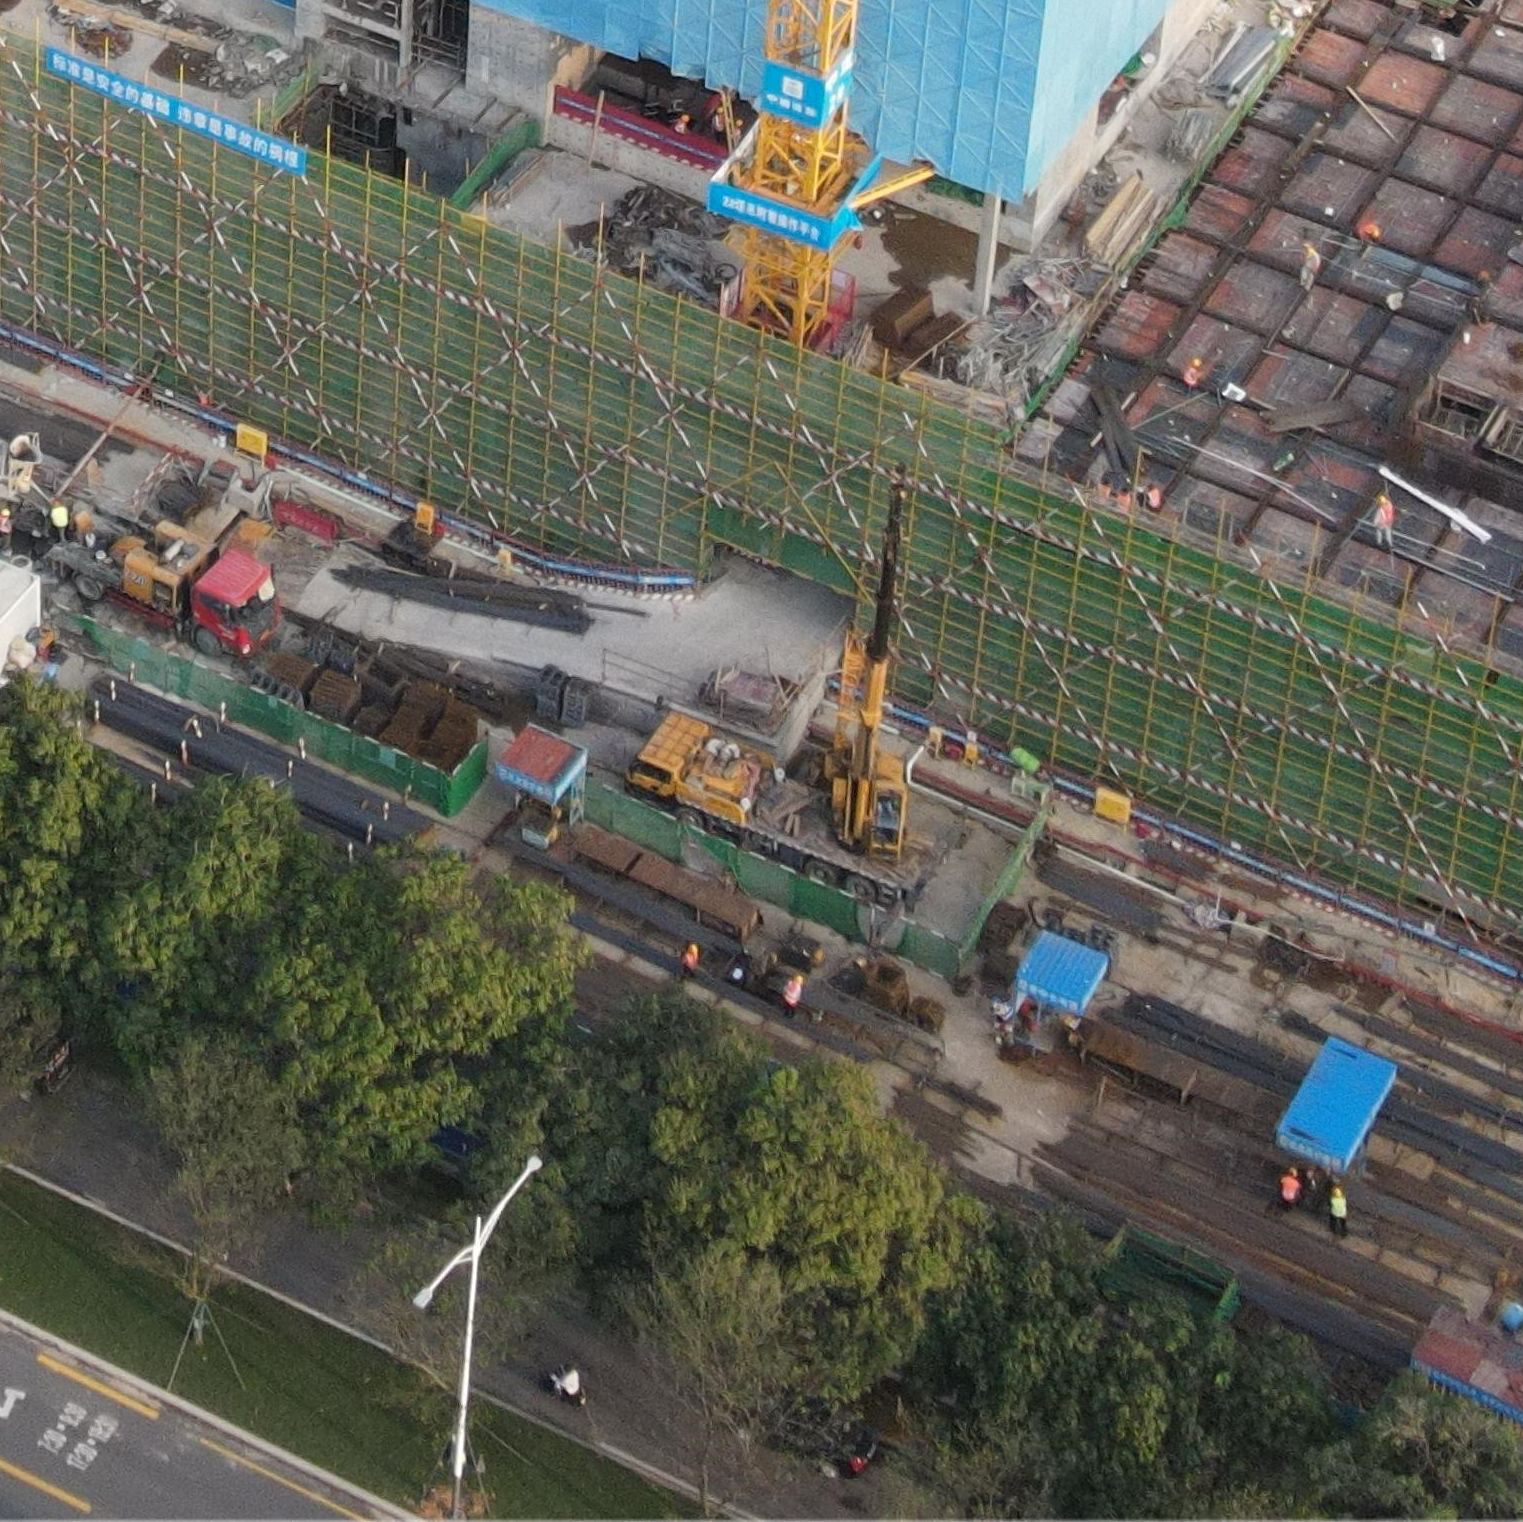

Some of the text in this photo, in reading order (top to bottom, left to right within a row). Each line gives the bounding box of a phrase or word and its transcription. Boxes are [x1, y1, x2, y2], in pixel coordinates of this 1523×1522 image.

[53, 53, 299, 169] 标准是安全的基础 违章是事故的祸根
